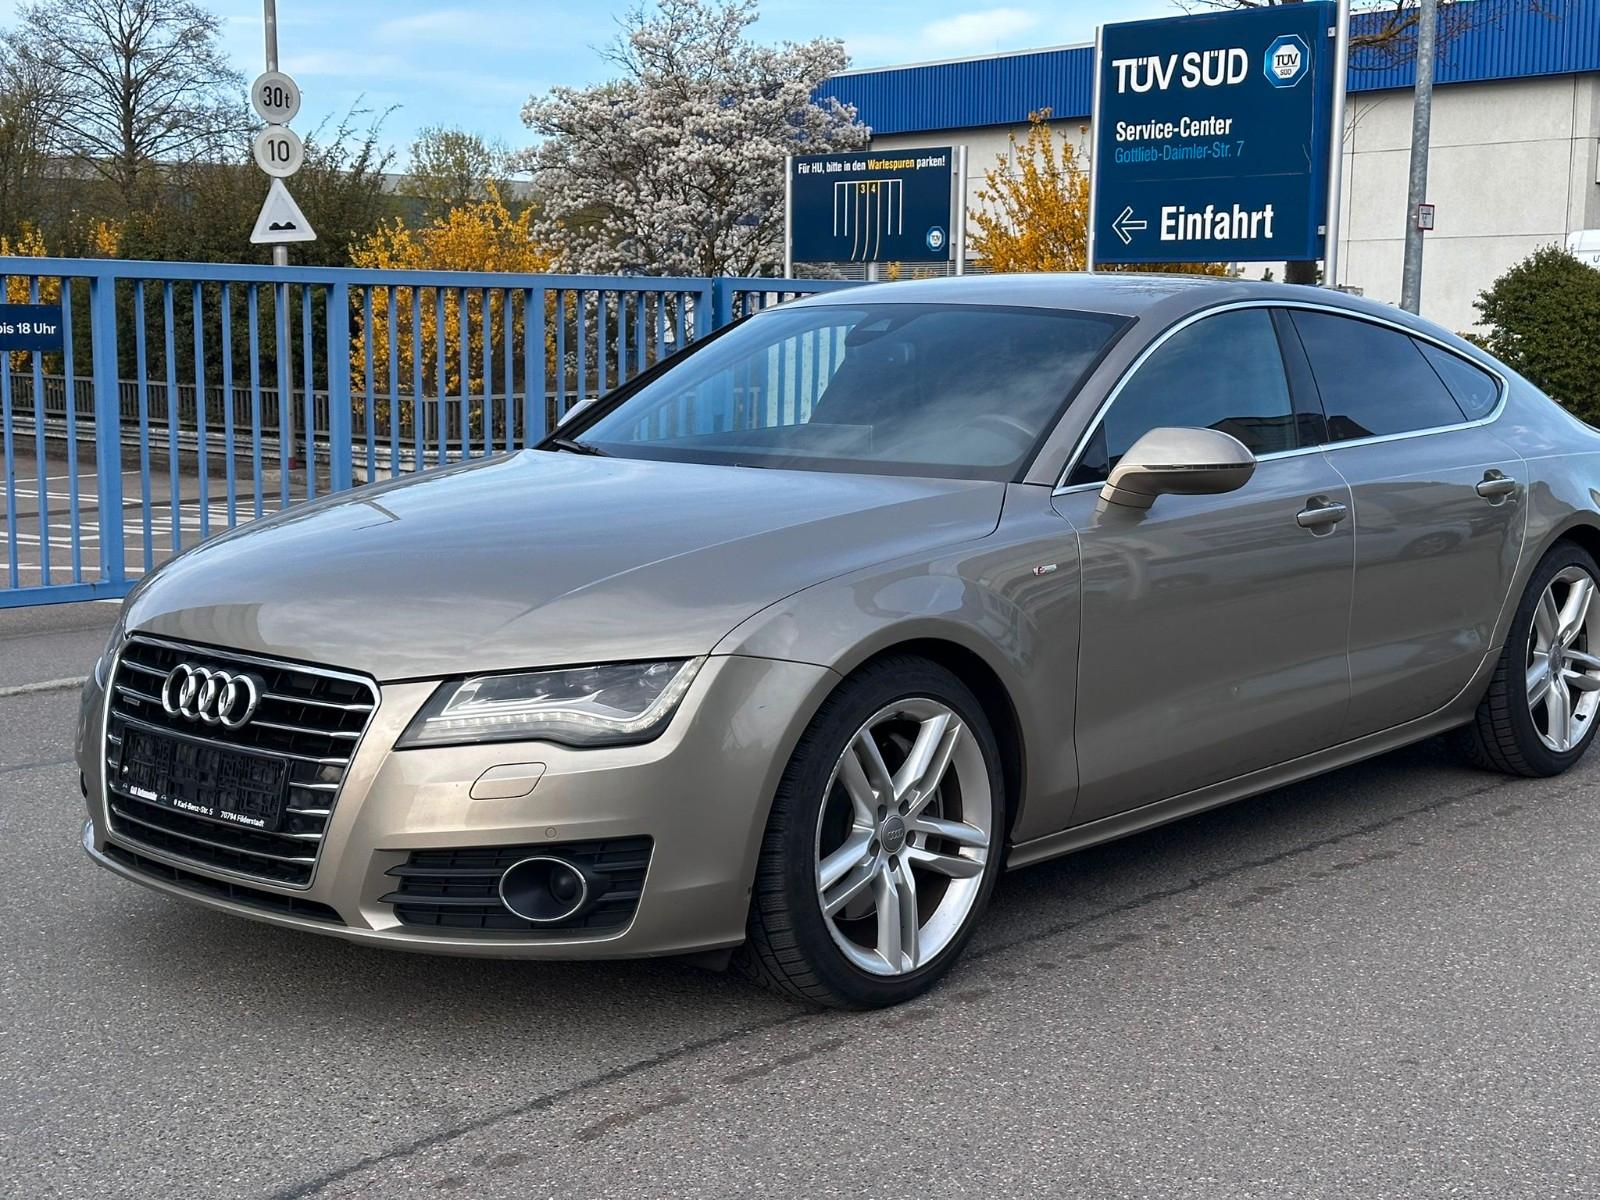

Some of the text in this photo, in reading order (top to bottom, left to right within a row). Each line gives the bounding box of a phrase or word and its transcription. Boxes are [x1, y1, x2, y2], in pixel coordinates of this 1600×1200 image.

[1275, 53, 1298, 66] TÜV
[1112, 48, 1249, 94] TÜV SÜD
[1280, 68, 1292, 76] SÜD
[1116, 116, 1232, 142] Service-Center
[268, 139, 290, 162] 10
[1115, 140, 1245, 163] Gottlieb-Daimler-Str. 7
[798, 154, 946, 174] Für HU, bitte in den Wartespuren parken!
[860, 184, 876, 194] 3 4
[1160, 203, 1274, 241] Einfahrt
[16, 322, 31, 334] 18
[33, 322, 57, 334] Uhr
